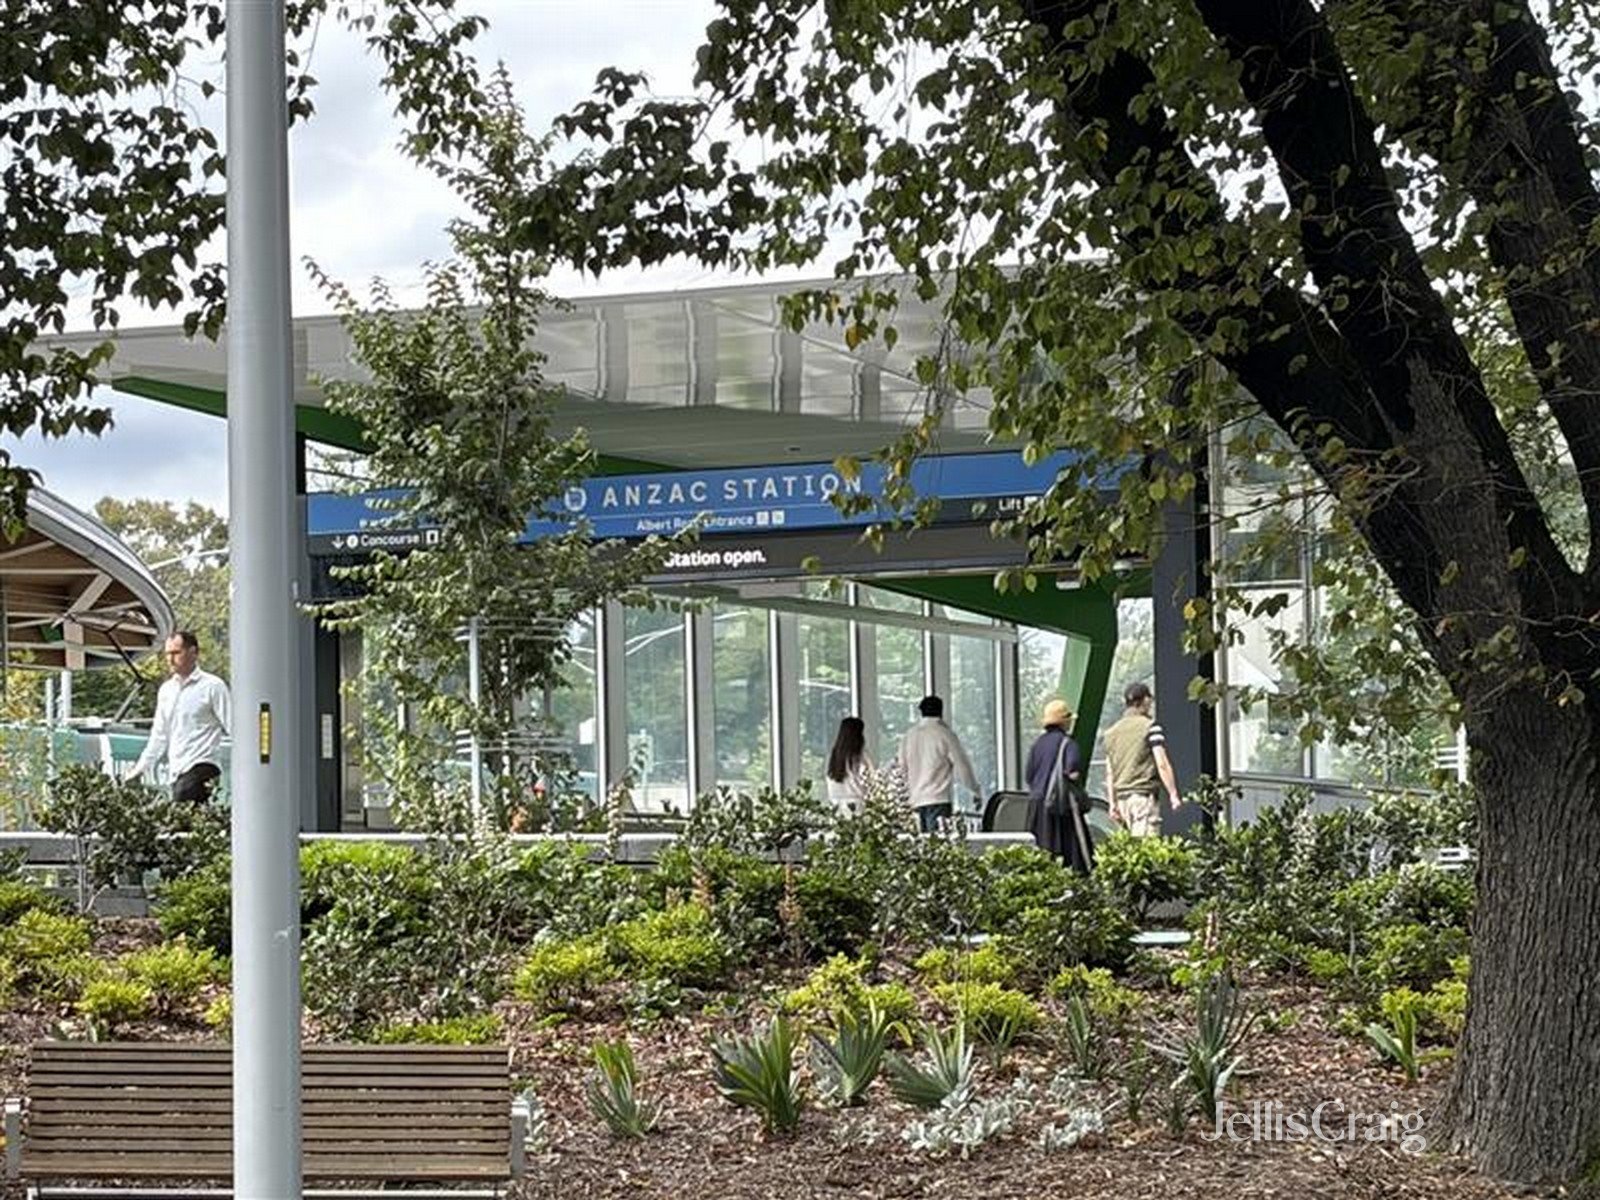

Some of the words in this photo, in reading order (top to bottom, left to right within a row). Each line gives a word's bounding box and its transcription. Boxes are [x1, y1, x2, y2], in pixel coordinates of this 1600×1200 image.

[602, 481, 708, 507] ANZAC
[723, 474, 861, 500] STATION
[636, 518, 671, 531] Albert
[360, 534, 420, 547] Concourse
[723, 549, 767, 568] open.
